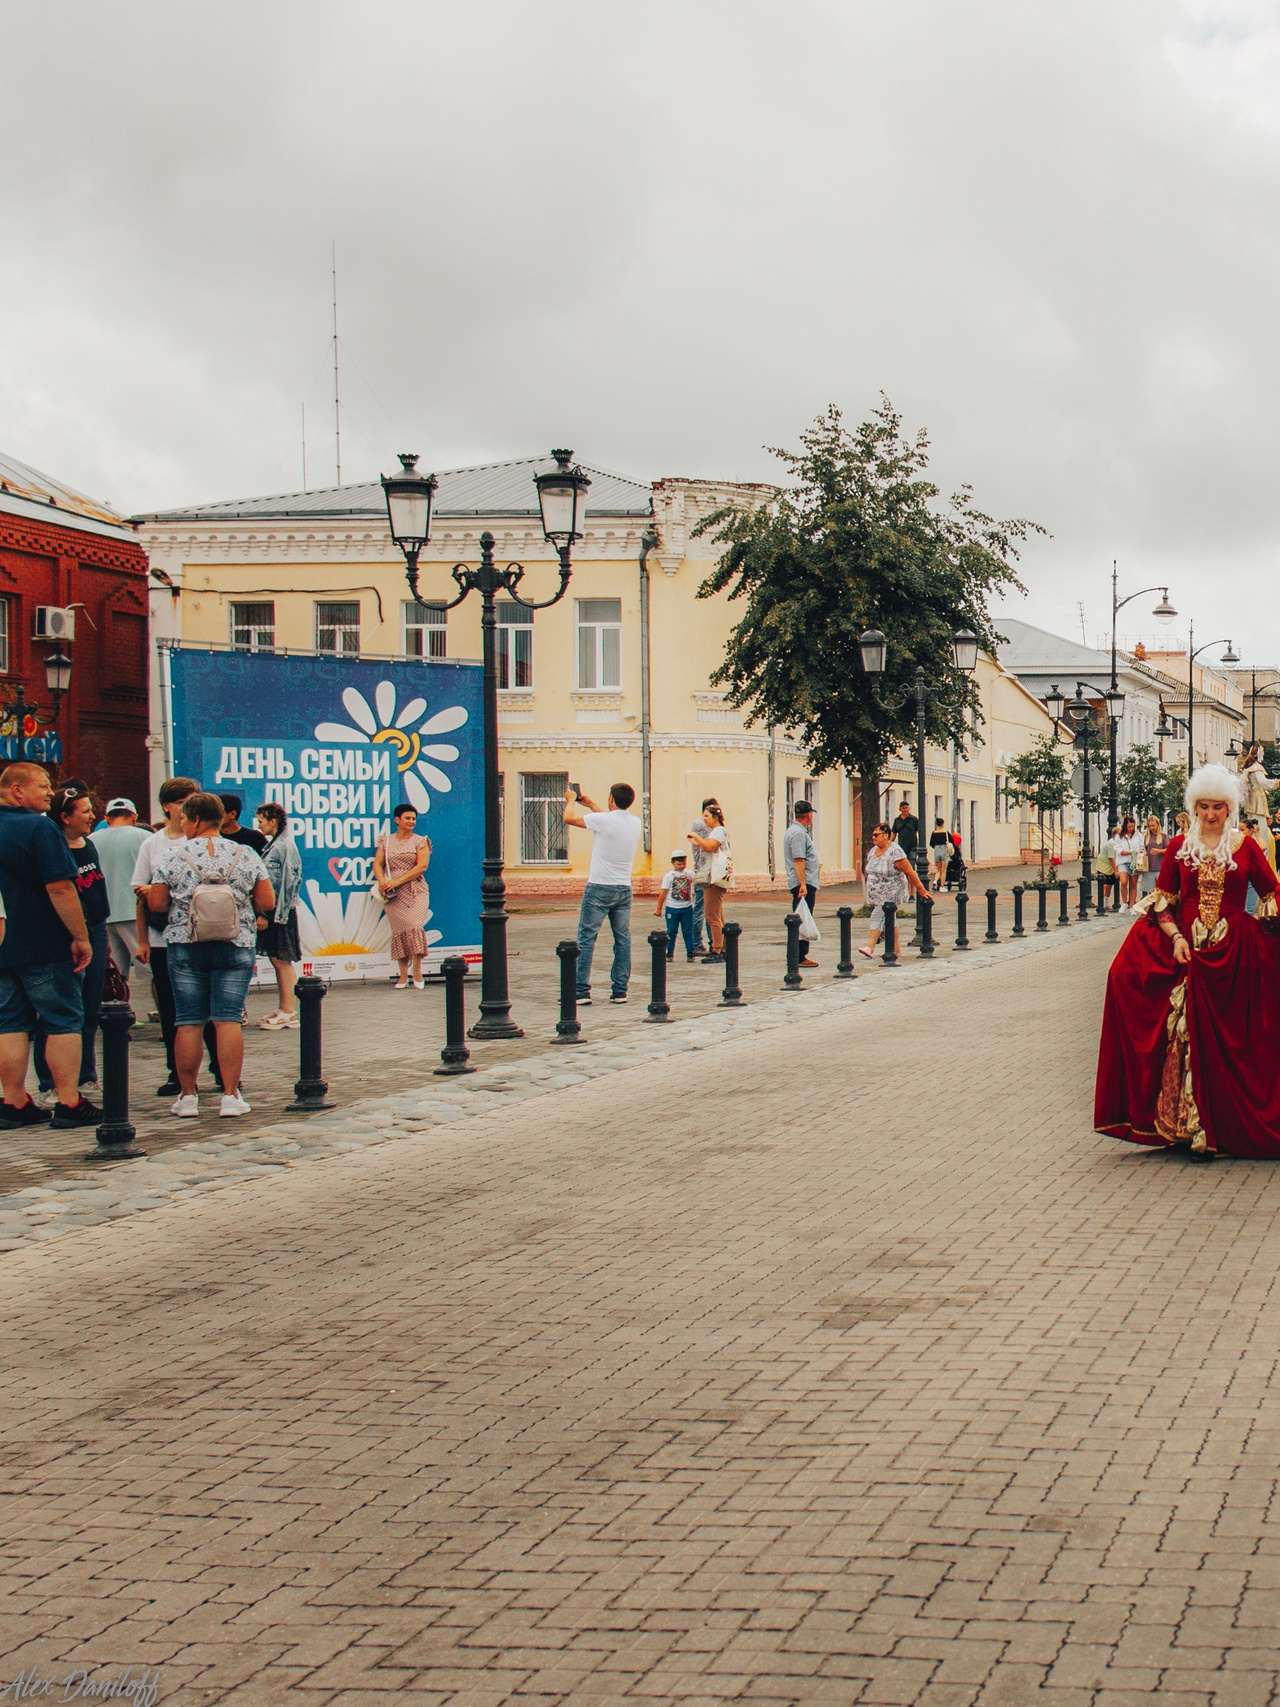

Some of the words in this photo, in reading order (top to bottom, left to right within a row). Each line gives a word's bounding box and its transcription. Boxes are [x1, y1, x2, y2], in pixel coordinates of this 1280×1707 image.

[215, 746, 295, 784] ДЕНЬ
[301, 748, 391, 781] СЕМЬИ
[265, 782, 366, 815] ЛЮБВИ
[373, 784, 391, 815] И
[253, 817, 391, 849] РНОСТИ
[338, 856, 377, 886] 202
